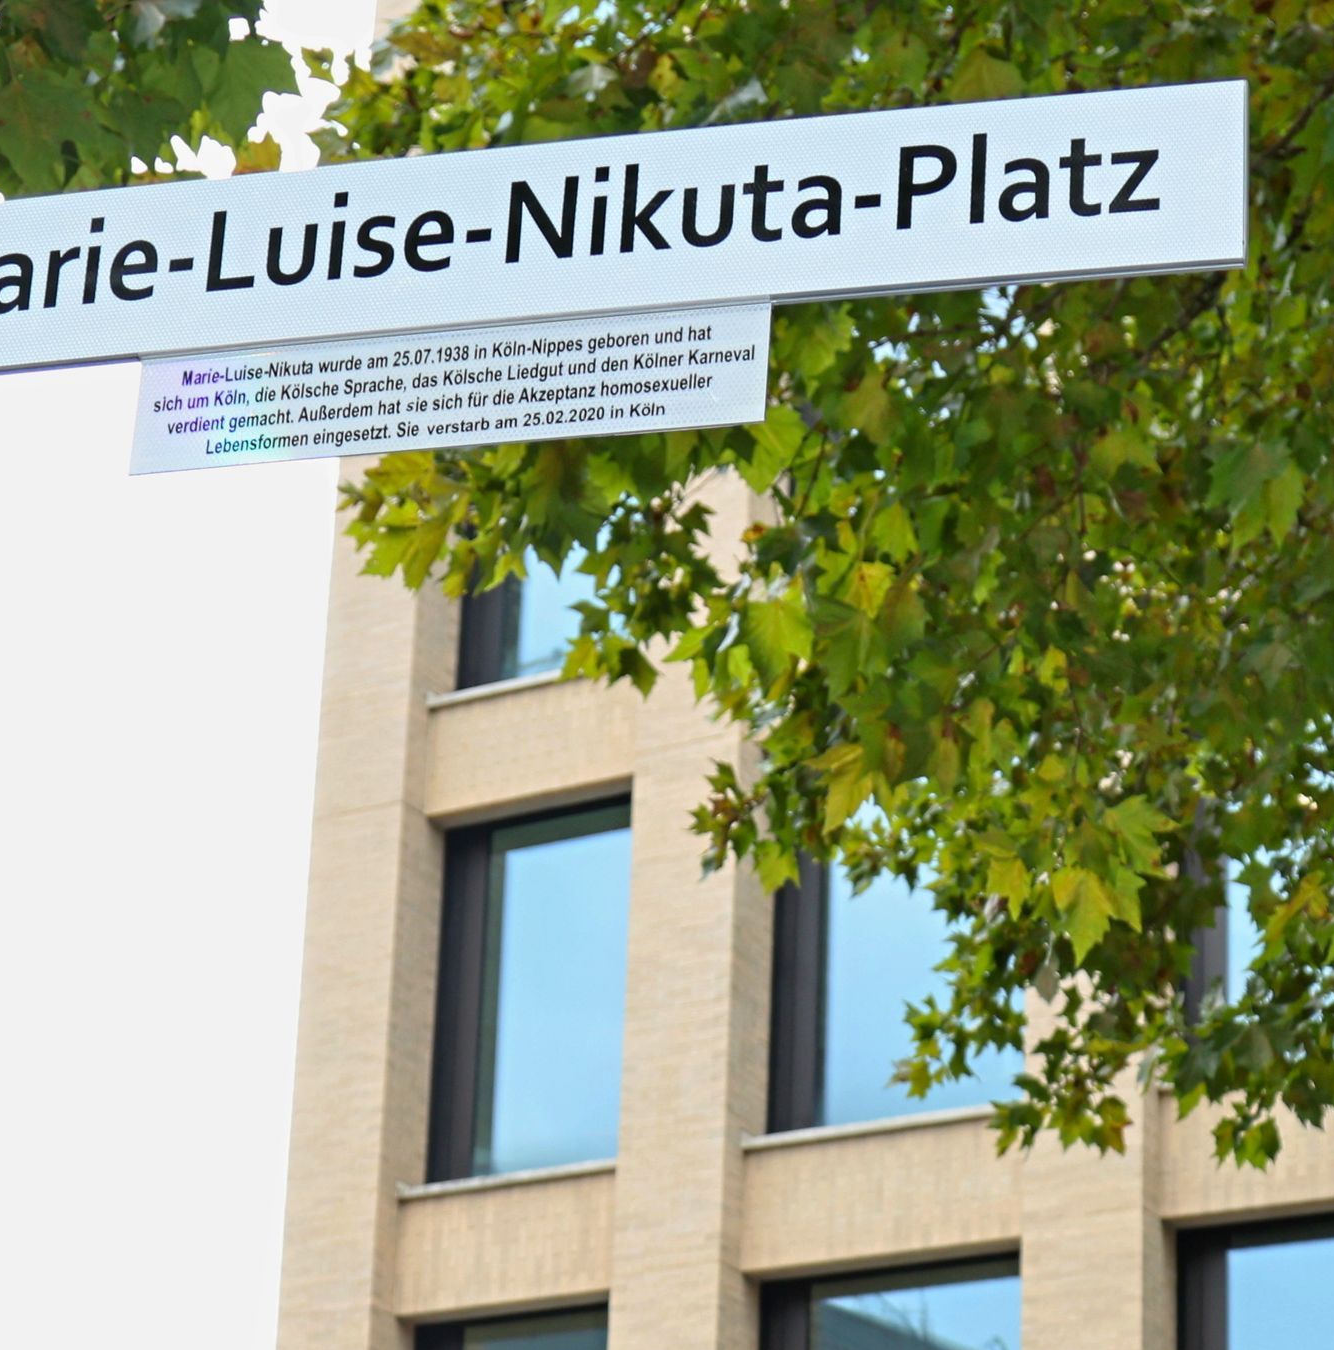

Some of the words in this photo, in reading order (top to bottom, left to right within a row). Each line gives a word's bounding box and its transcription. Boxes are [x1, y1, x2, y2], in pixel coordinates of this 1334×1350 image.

[153, 394, 182, 413] sich
[187, 395, 209, 410] um
[214, 389, 249, 407] Köln,
[255, 386, 276, 403] die
[281, 381, 339, 401] Kölsche
[344, 376, 407, 398] Sprache,
[412, 371, 438, 389] das
[443, 364, 502, 386] Kölsche
[507, 360, 564, 382] Liedgut
[568, 358, 596, 375] und
[601, 354, 628, 372] den
[633, 349, 683, 368] Kölner
[688, 345, 756, 365] Karneval
[182, 360, 313, 386] Marie-Luise-Nikuta
[319, 355, 362, 374] wurde
[367, 356, 388, 370] am
[393, 345, 469, 367] 25.07.1938
[475, 344, 487, 359] in
[492, 337, 583, 358] Köln-Nippes
[588, 333, 650, 353] geboren
[655, 327, 683, 344] und
[688, 325, 712, 342] hat
[167, 416, 225, 435] verdient
[229, 408, 294, 433] gemacht.
[298, 402, 373, 423] Außerdem
[378, 399, 401, 414] hat
[406, 396, 428, 413] sie
[432, 393, 463, 411] sich
[468, 391, 489, 408] für
[493, 388, 515, 405] die
[518, 382, 595, 404] Akzeptanz
[600, 374, 713, 397] homosexueller
[206, 433, 309, 455] Lebensformen
[313, 424, 391, 447] eingesetzt.
[396, 420, 419, 438] Sie
[427, 415, 489, 436] verstarb
[495, 416, 518, 430] am
[523, 407, 605, 427] 25.02.2020
[610, 405, 624, 419] in
[629, 402, 666, 417] Köln
